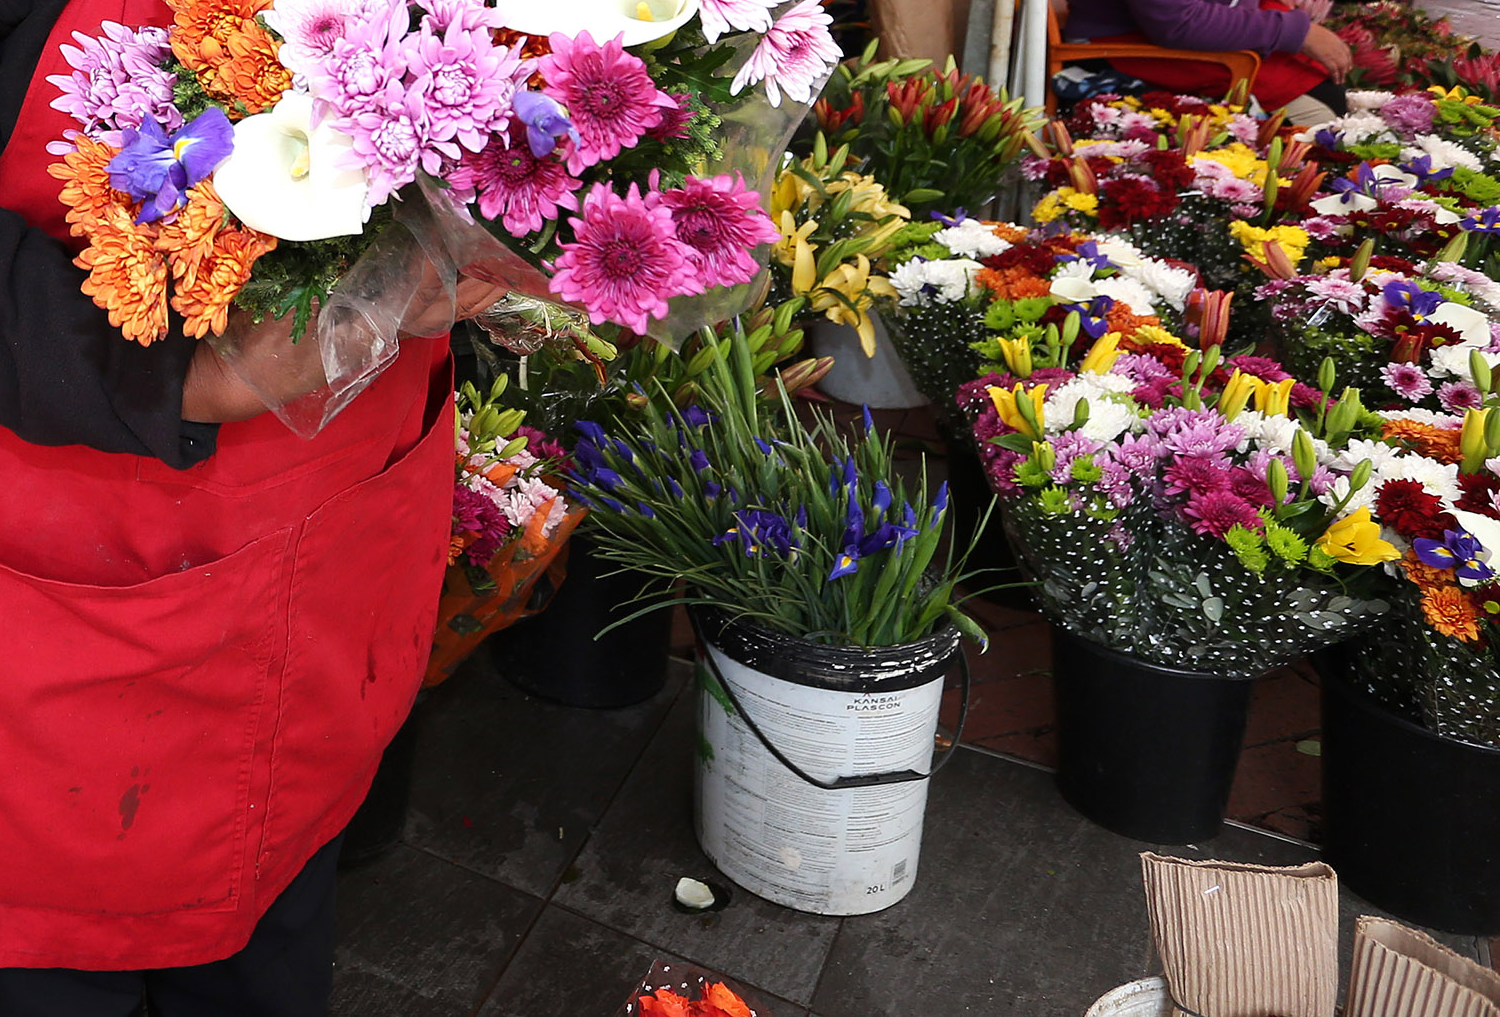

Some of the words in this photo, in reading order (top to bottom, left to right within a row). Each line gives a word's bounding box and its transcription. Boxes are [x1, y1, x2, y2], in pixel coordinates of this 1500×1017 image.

[854, 696, 898, 704] KANSAI
[846, 702, 901, 711] PLASCON
[866, 885, 879, 894] 20
